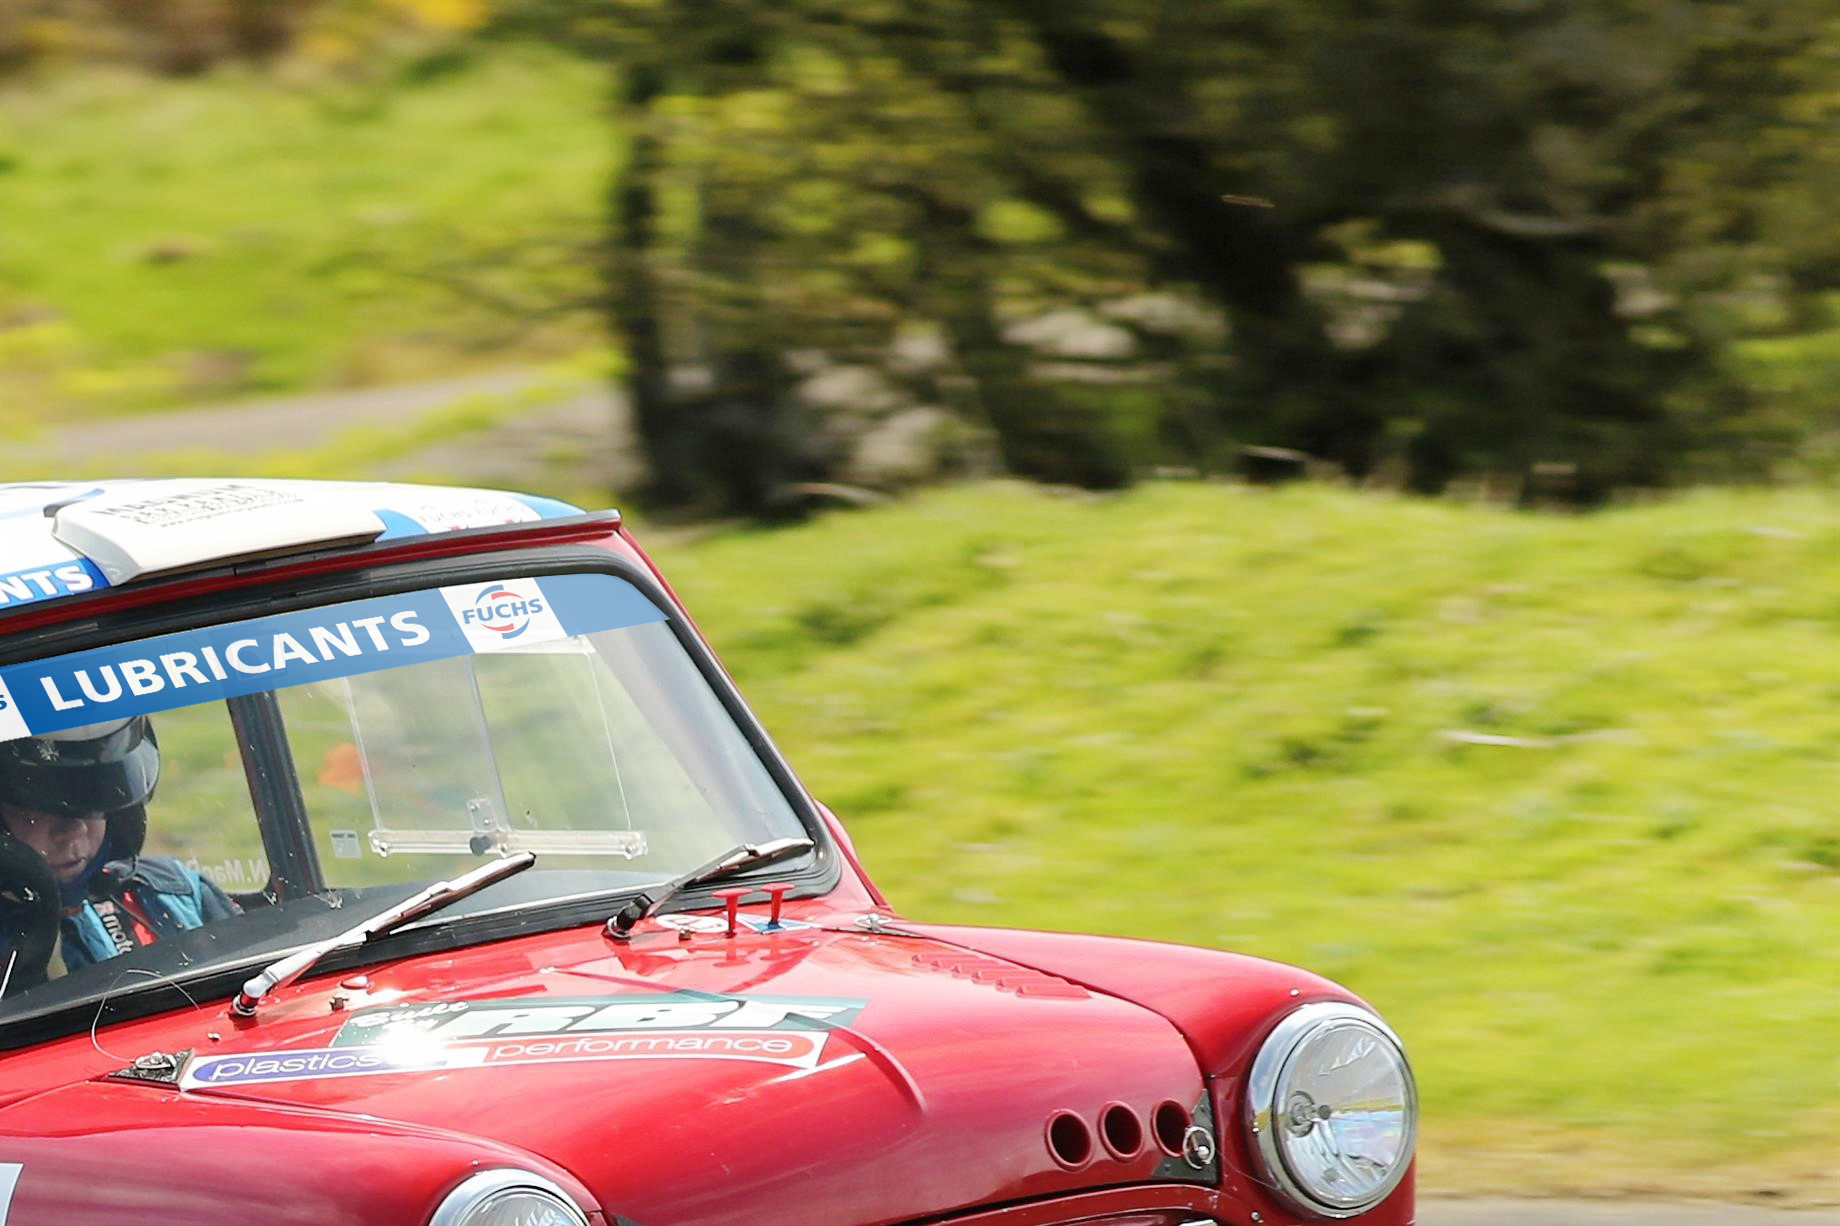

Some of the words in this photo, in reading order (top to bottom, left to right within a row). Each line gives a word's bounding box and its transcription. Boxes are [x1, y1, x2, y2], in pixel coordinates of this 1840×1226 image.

[462, 596, 544, 627] FUCHS
[40, 609, 431, 713] LUBRICANTS
[492, 1033, 794, 1064] performance
